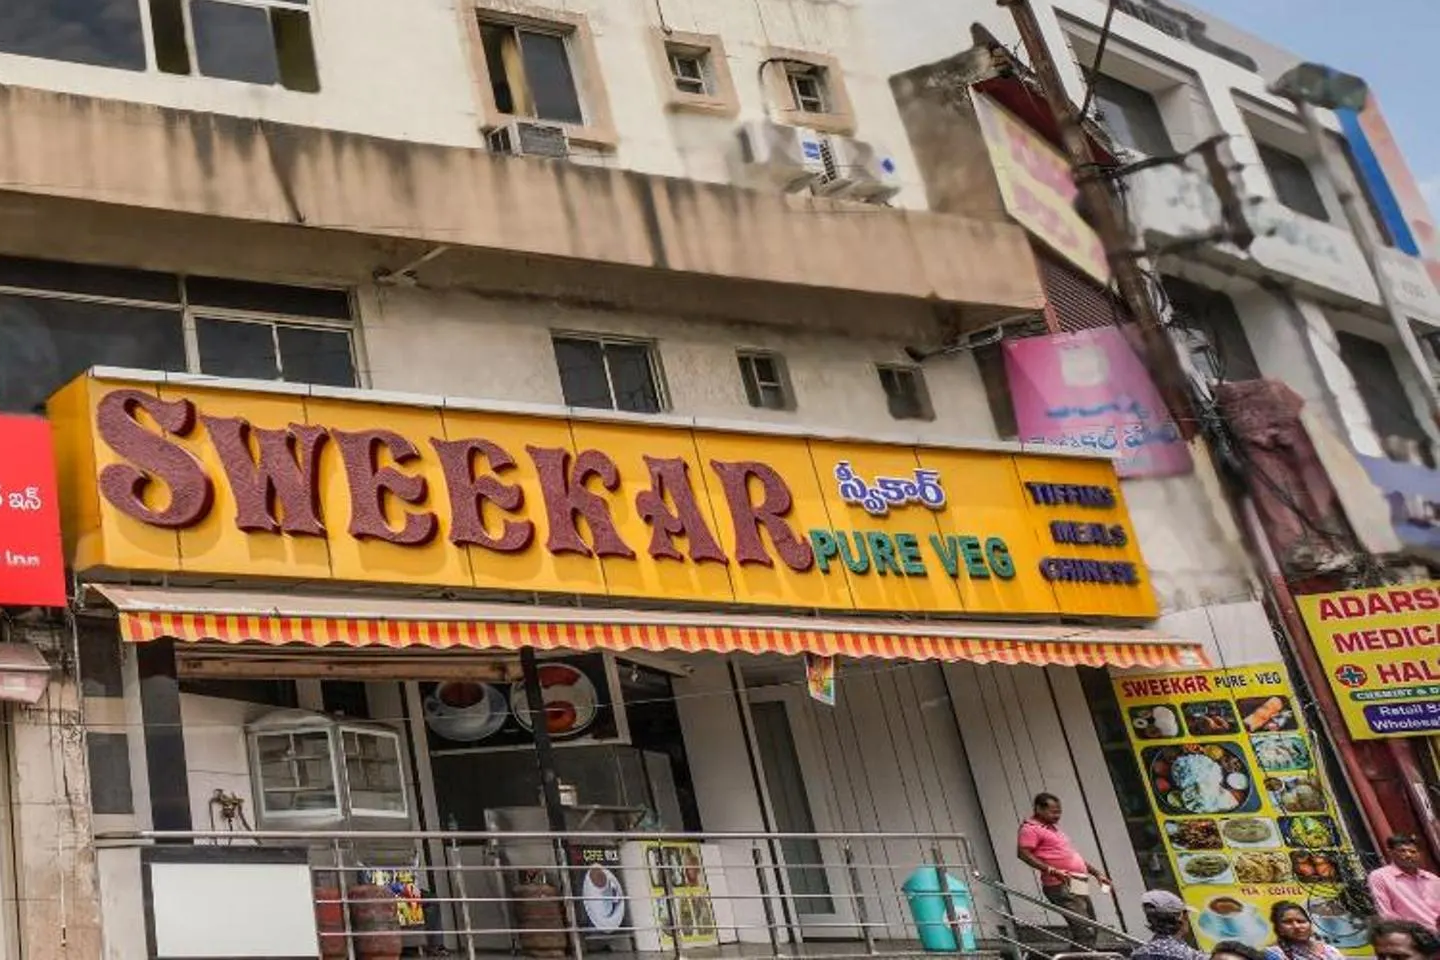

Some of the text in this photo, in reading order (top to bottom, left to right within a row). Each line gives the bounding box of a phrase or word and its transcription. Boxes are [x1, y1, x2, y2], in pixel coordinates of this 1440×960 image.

[97, 388, 815, 572] SWEEKAR
[1024, 482, 1117, 509] TIFFINS
[6, 550, 40, 566] Inn
[809, 528, 1016, 580] PURE VEG
[1319, 587, 1440, 621] ADARS
[1332, 624, 1440, 653] MEDIC
[1122, 671, 1282, 698] SWEEKAR PURE VEG
[1377, 659, 1440, 684] HAL
[1378, 703, 1423, 717] Retail
